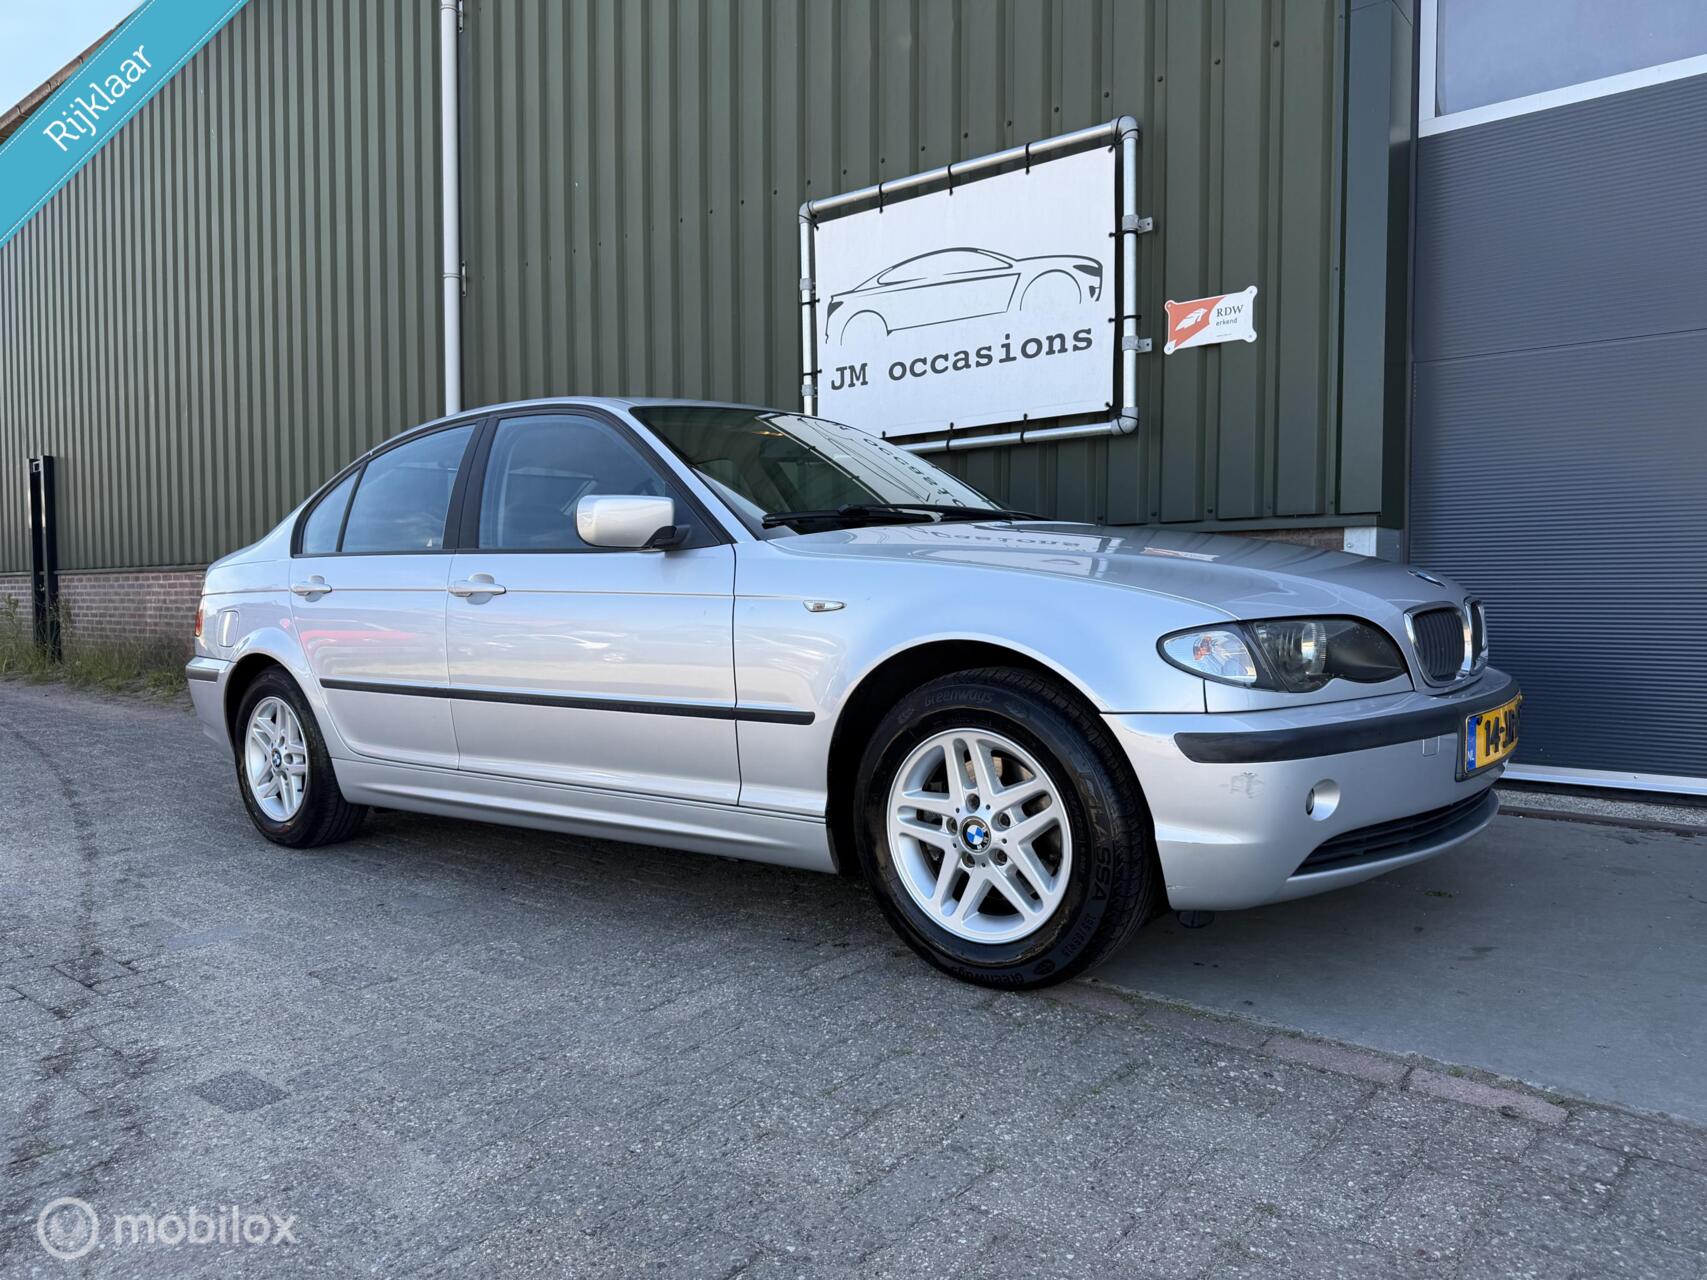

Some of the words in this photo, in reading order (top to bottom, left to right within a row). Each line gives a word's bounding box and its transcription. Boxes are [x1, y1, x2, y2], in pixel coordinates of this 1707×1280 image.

[1217, 305, 1243, 318] RDW
[1216, 317, 1238, 326] erkend
[831, 363, 868, 390] JM
[888, 326, 1094, 381] occasions
